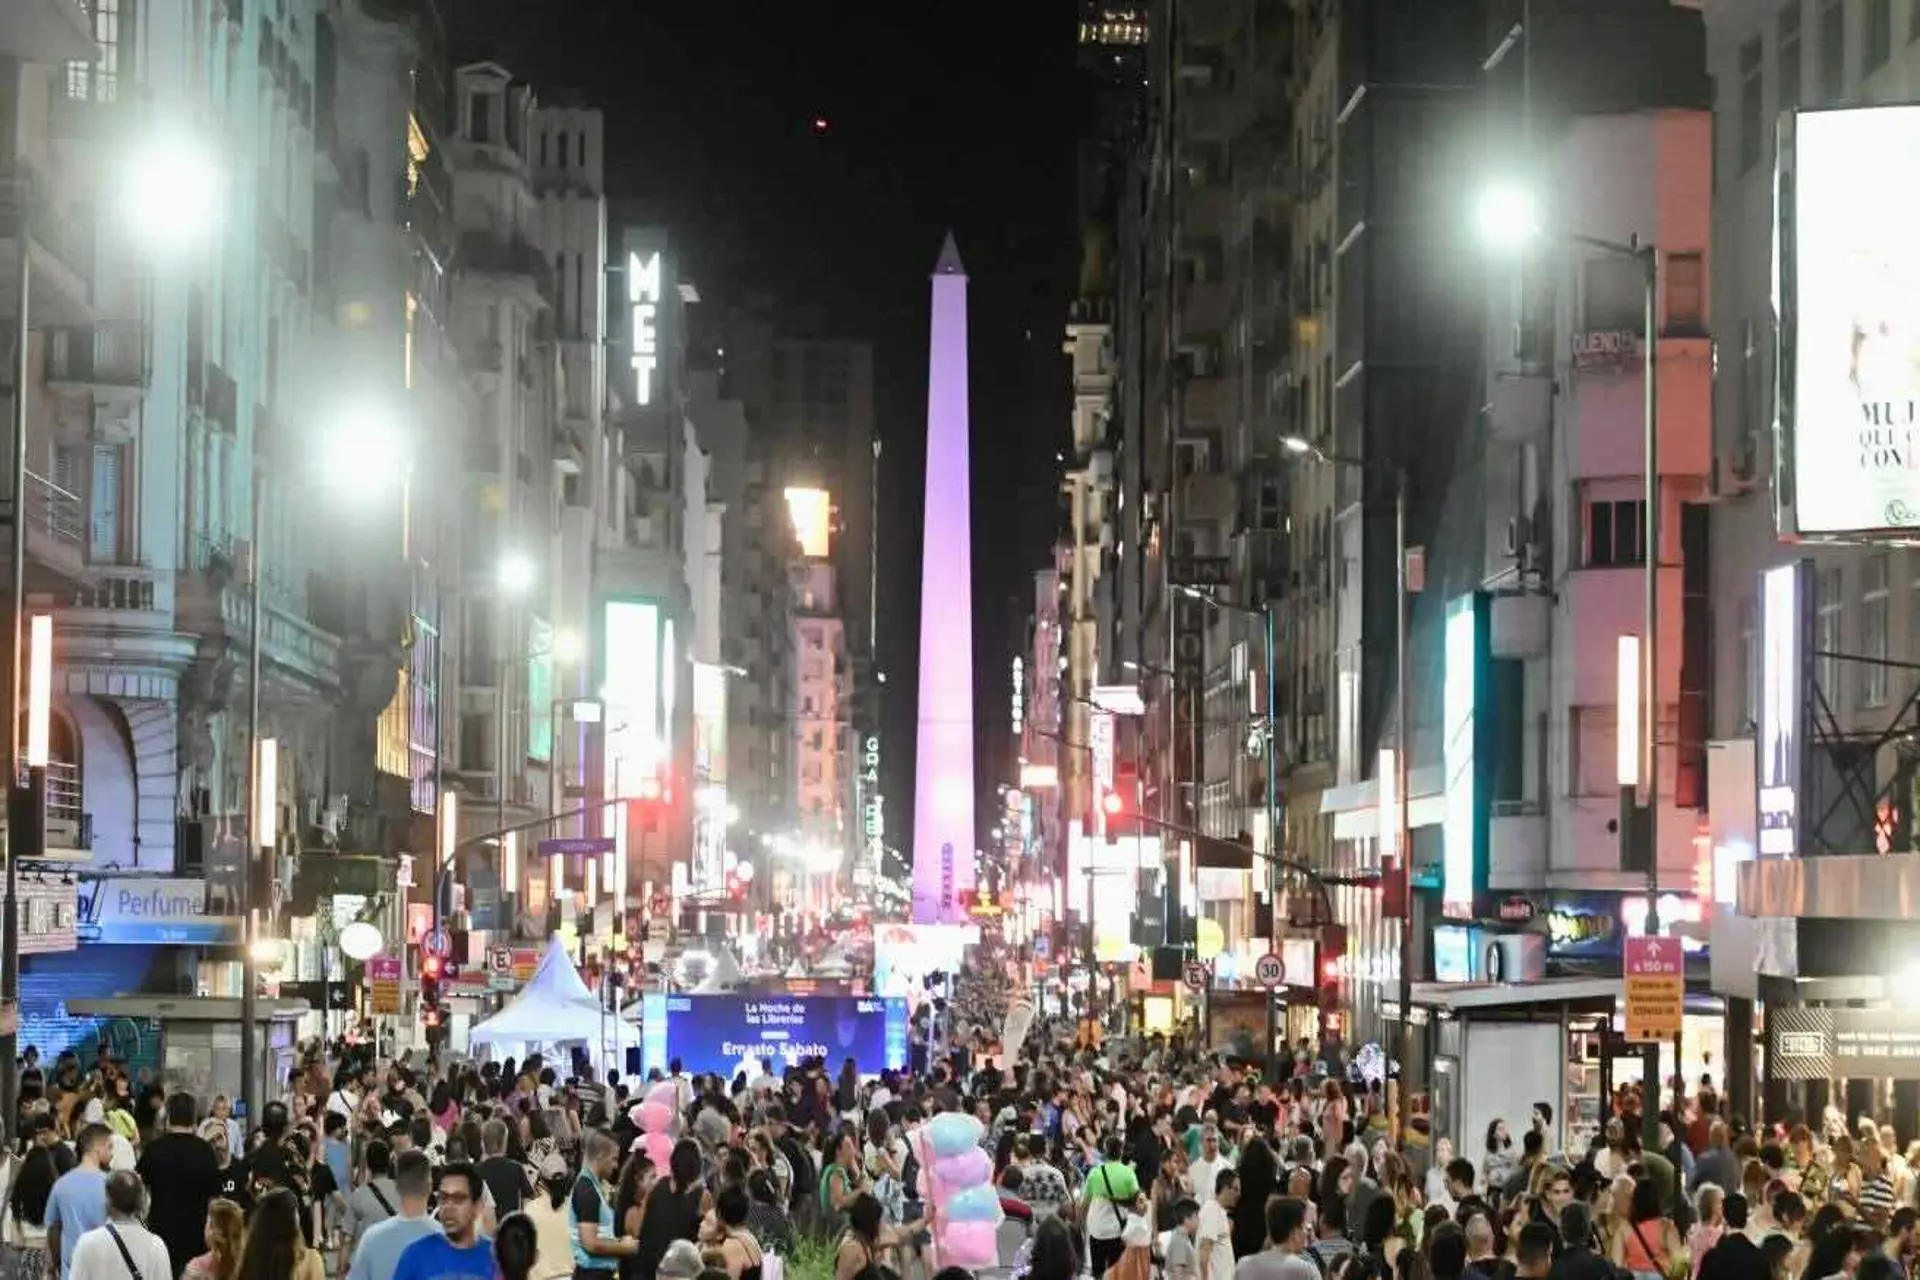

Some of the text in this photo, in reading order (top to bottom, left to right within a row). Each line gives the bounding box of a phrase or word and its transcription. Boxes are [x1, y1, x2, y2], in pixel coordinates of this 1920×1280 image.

[629, 251, 660, 405] MET
[1262, 963, 1279, 977] 30
[759, 1002, 790, 1013] Noche
